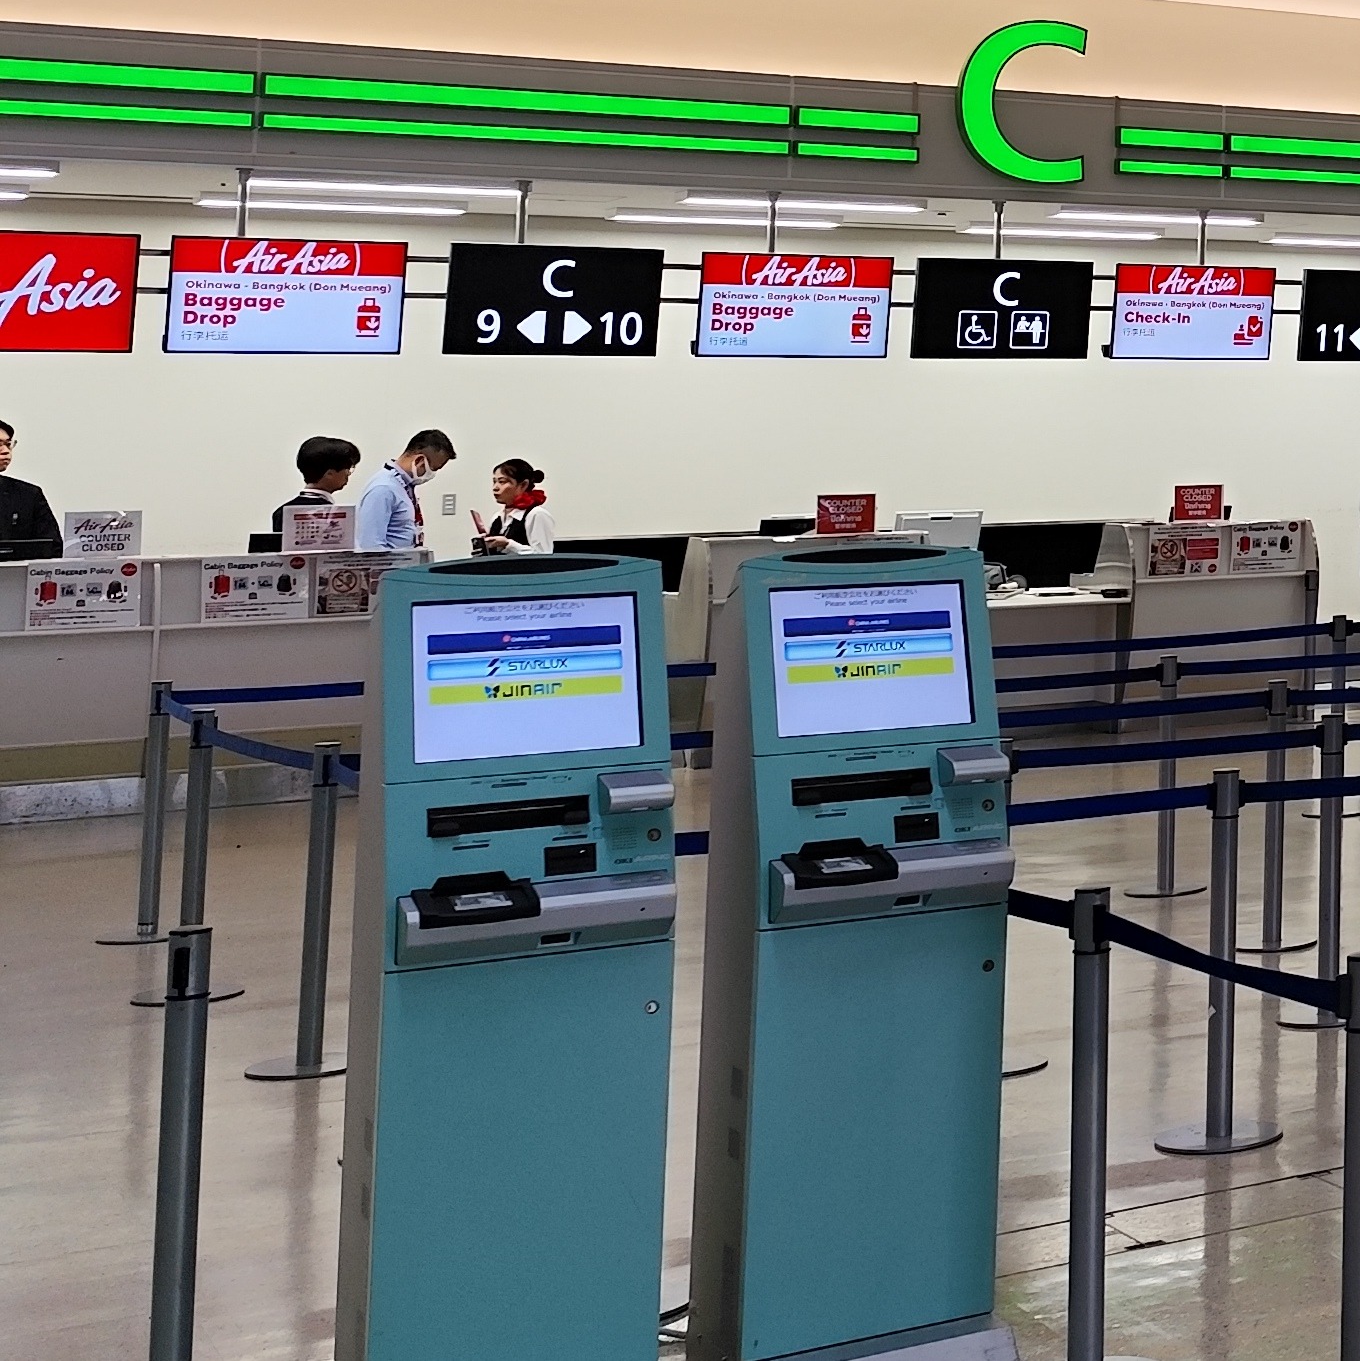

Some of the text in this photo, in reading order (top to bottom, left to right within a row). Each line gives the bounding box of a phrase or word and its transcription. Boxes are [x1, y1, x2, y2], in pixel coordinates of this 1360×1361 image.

[956, 19, 1088, 185] C
[232, 240, 351, 275] AirAsia
[541, 259, 574, 298] C
[752, 255, 848, 286] AirAsia
[185, 279, 393, 295] Okinawa Bangkok (Don Mueang)
[1158, 266, 1237, 295] AirAsia
[992, 271, 1021, 307] C
[183, 292, 286, 312] Baggage
[713, 291, 881, 304] Okinawa Bangkok (Don Mueang)
[1125, 298, 1164, 308] Okinawa
[1170, 300, 1207, 309] Bangkok
[712, 302, 795, 320] Baggage
[1124, 310, 1191, 324] Check-In
[182, 310, 237, 329] Drop
[475, 308, 644, 346] 9 10
[711, 318, 755, 335] Drop
[1317, 323, 1344, 353] 11
[1180, 488, 1216, 496] COUNTER
[1183, 494, 1212, 502] CLOSED
[826, 499, 867, 507] COUNTER
[829, 506, 863, 514] CLOSED
[79, 533, 131, 543] COUNTER
[81, 543, 125, 552] CLOSED
[853, 640, 907, 653] STARLUX
[507, 657, 569, 672] STARLUX
